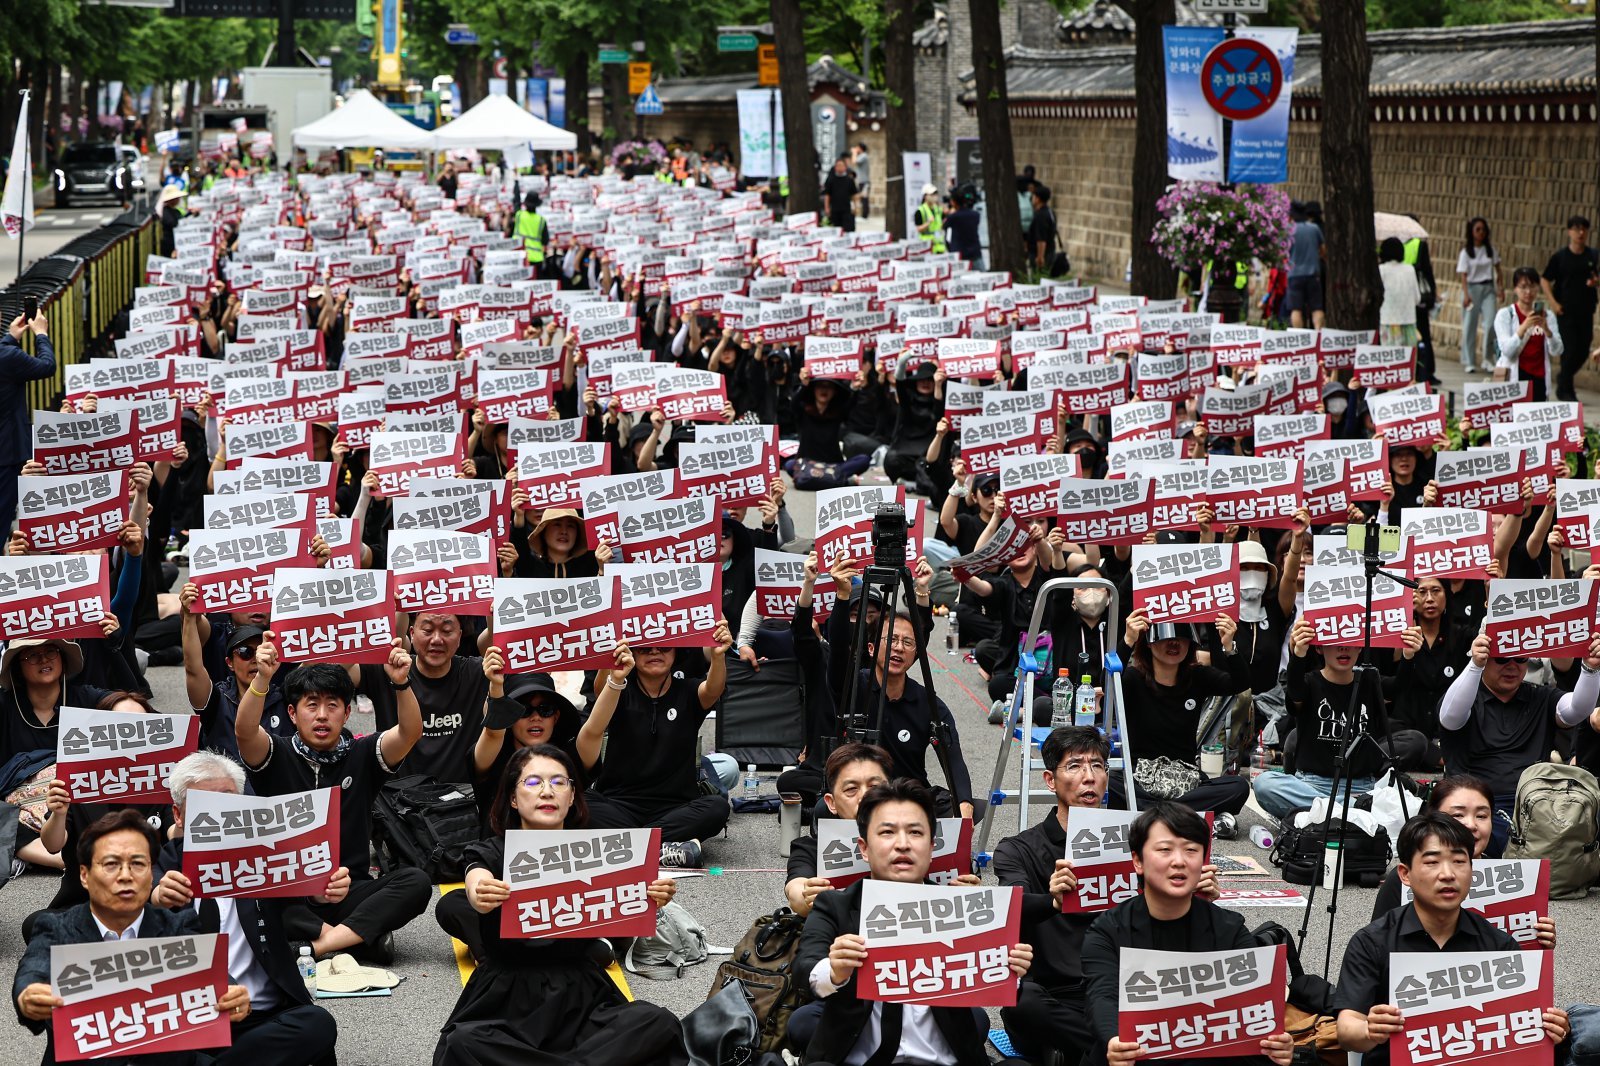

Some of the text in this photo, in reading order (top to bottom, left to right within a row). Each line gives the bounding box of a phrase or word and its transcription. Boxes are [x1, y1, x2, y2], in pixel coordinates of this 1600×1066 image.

[1169, 61, 1202, 74] 문화상
[1213, 71, 1271, 87] 주정차금지
[356, 299, 401, 317] 순직인정
[349, 334, 401, 355] 순직인정
[582, 319, 630, 341] 순직인정
[1014, 332, 1060, 351] 순직인정
[1264, 333, 1311, 351] 순직인정
[1323, 332, 1368, 349] 순직인정
[228, 343, 280, 364] 순직인정
[413, 339, 452, 360] 상규명
[499, 348, 554, 365] 순직인정
[1358, 347, 1406, 366] 순직인정
[93, 361, 160, 388] 순직인정
[349, 359, 402, 381] 순직인정
[810, 358, 859, 376] 진상규명
[944, 357, 997, 376] 진상규명
[1065, 365, 1120, 387] 순직인정
[1140, 356, 1187, 377] 순직인정
[1360, 368, 1411, 387] 진상규명
[228, 380, 287, 405] 순직인정
[298, 373, 339, 392] 직인정
[387, 375, 450, 400] 순직인정
[480, 371, 539, 396] 순직인정
[658, 373, 714, 394] 순직인정
[1142, 378, 1189, 400] 진상규명
[1466, 383, 1521, 406] 순직인정
[138, 403, 168, 424] 인정
[342, 399, 386, 420] 순직인
[486, 395, 550, 421] 진상규명
[663, 394, 724, 418] 진상규명
[986, 392, 1046, 416] 순직인정
[1069, 388, 1127, 411] 진상규명
[1206, 394, 1260, 411] 순직인정
[1376, 397, 1432, 419] 순직인정
[37, 413, 121, 443] 순직인정
[964, 416, 1028, 445] 순직인정
[1113, 403, 1166, 432] 순직인정
[1208, 418, 1253, 434] 진상규
[1257, 417, 1318, 441] 순직인정
[1384, 418, 1442, 444] 진상규명
[1471, 407, 1513, 429] 진상규
[141, 430, 178, 453] 규명
[229, 424, 299, 455] 순직인정
[373, 434, 447, 463] 순직인정
[1493, 424, 1552, 448] 순직인정
[45, 445, 134, 475] 진상규명
[521, 444, 596, 475] 순직인정
[682, 444, 754, 475] 순직인정
[1002, 456, 1070, 487] 순직인정
[1303, 461, 1336, 486] 인정
[1439, 453, 1511, 481] 순직인정
[243, 464, 321, 492] 순직인정
[1210, 460, 1287, 490] 순직인정
[22, 474, 111, 514] 순직인정
[528, 481, 581, 506] 진상규
[585, 472, 666, 513] 순직인정
[1009, 489, 1058, 516] 진상규
[1062, 481, 1139, 510] 순직인정
[1308, 491, 1348, 516] 규명
[1443, 482, 1520, 509] 진상규명
[209, 494, 297, 530] 순직인정
[622, 499, 706, 539] 순직인정
[1216, 494, 1297, 522] 진상규명
[30, 507, 123, 549] 진상규명
[1066, 511, 1149, 541] 진상규명
[1404, 511, 1481, 540] 순직인정
[193, 530, 287, 571] 순직인정
[390, 535, 482, 570] 순직인정
[823, 531, 873, 569] 진상규
[1136, 545, 1222, 583] 순직인정
[1413, 545, 1492, 575] 진상규명
[202, 574, 273, 609] 진상규
[276, 571, 378, 613] 순직인정
[396, 573, 494, 608] 진상규명
[495, 579, 603, 625] 순직인정
[1145, 581, 1235, 618] 진상규명
[1492, 581, 1580, 618] 순직인정
[1, 596, 105, 637] 진상규명
[621, 604, 716, 642] 진상규명
[281, 615, 393, 660] 진상규명
[507, 623, 618, 672] 진상규명
[1497, 617, 1590, 653] 진상규명
[423, 713, 462, 729] Jeep
[62, 717, 175, 755] 순직인정
[190, 794, 316, 843] 순직인정
[1071, 824, 1131, 859] 순직
[198, 841, 332, 895] 진상규명
[508, 832, 634, 884] 순직인정
[1078, 873, 1138, 907] 진상
[1469, 862, 1524, 899] 인정
[517, 881, 649, 933] 진상규명
[865, 890, 995, 939] 순직인정
[56, 937, 198, 997] 순직인정
[874, 945, 1010, 996] 진상규명
[1124, 952, 1258, 1003] 순직인정
[1394, 954, 1526, 1009] 순직인정
[71, 984, 220, 1054] 진상규명
[1135, 1000, 1276, 1054] 진상규명
[1406, 1007, 1545, 1064] 진상규명
